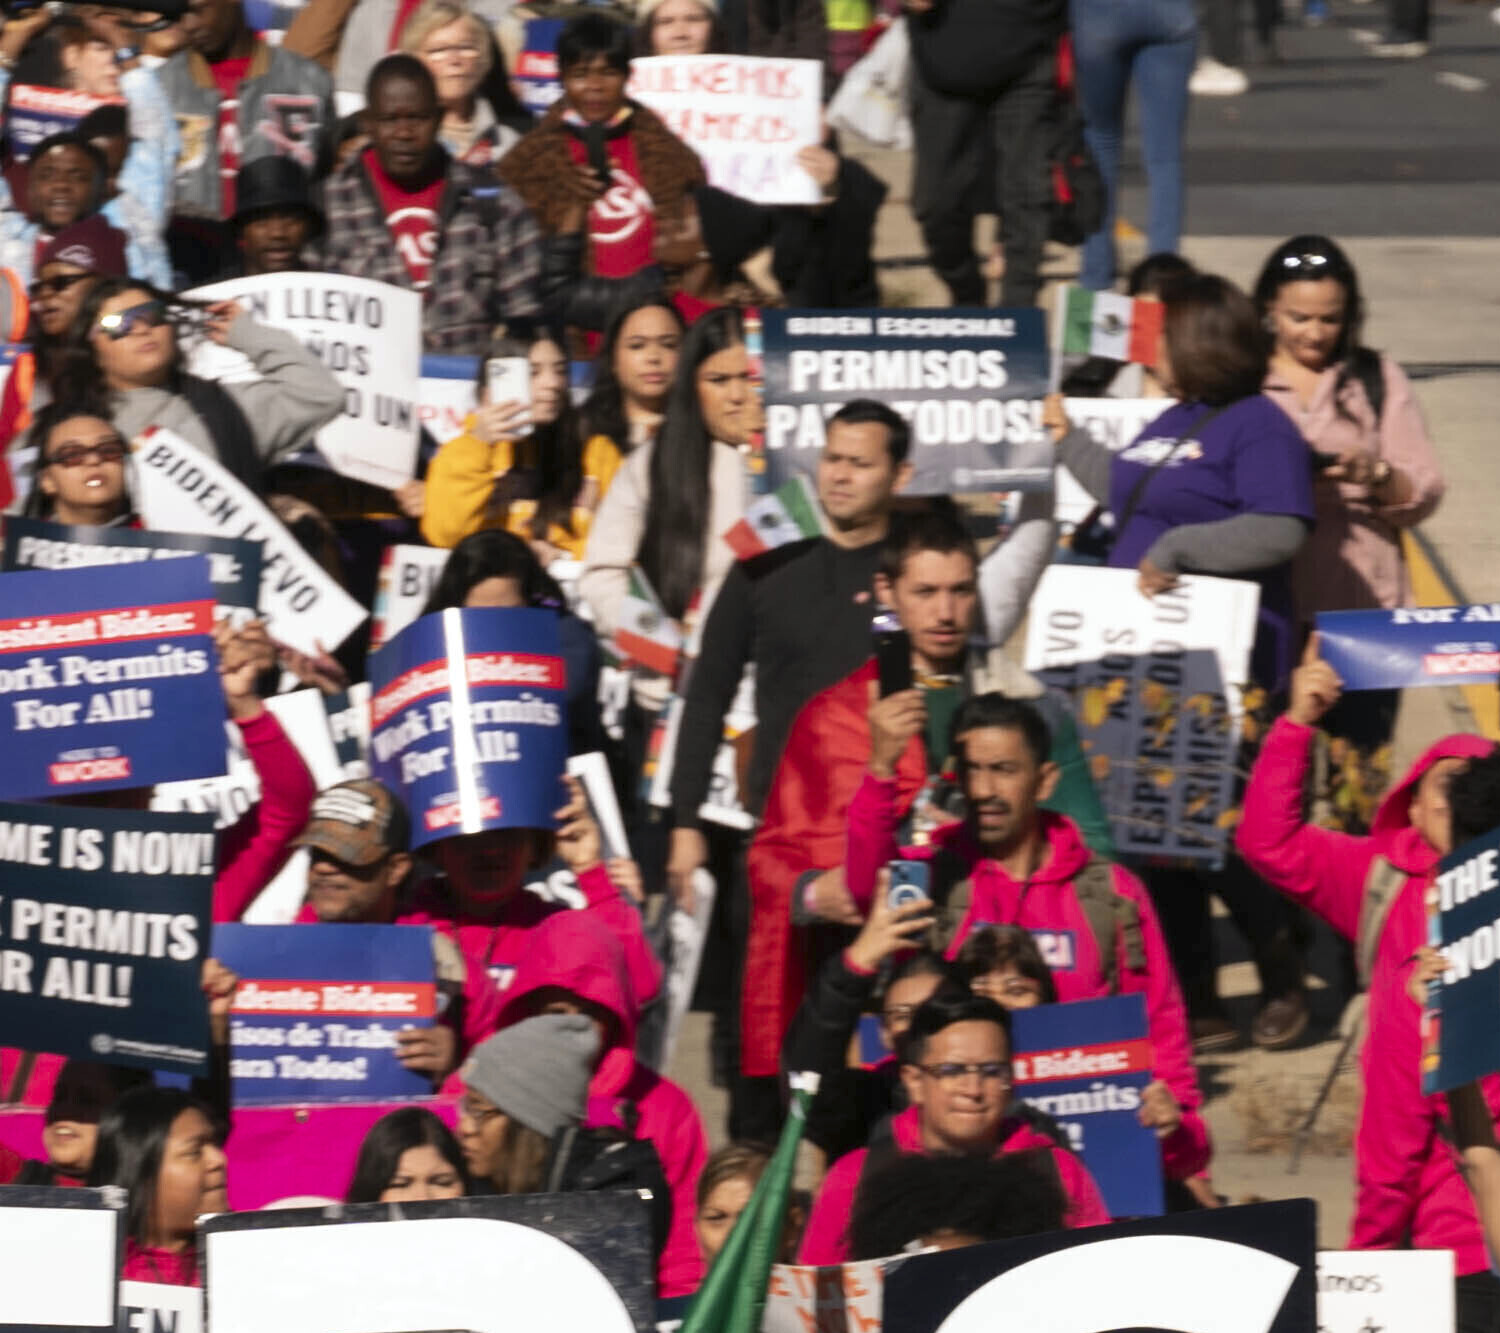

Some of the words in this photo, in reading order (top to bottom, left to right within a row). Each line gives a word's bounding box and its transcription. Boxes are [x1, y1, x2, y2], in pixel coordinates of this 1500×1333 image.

[285, 288, 383, 329] LLEVO
[877, 317, 1016, 337] ESCUCHA!
[788, 350, 1008, 392] PERMISOS
[101, 608, 198, 641] Biden:
[71, 642, 208, 691] Permits
[14, 699, 77, 731] For
[84, 689, 152, 727] All!
[61, 828, 104, 872] IS
[111, 831, 215, 876] NOW!
[1438, 849, 1498, 912] THE
[11, 897, 199, 964] PERMITS
[42, 954, 131, 1007] ALL!
[235, 983, 319, 1011] dente
[321, 985, 417, 1012] Biden:
[275, 1055, 368, 1080] Todos!
[1033, 1050, 1129, 1080] Biden:
